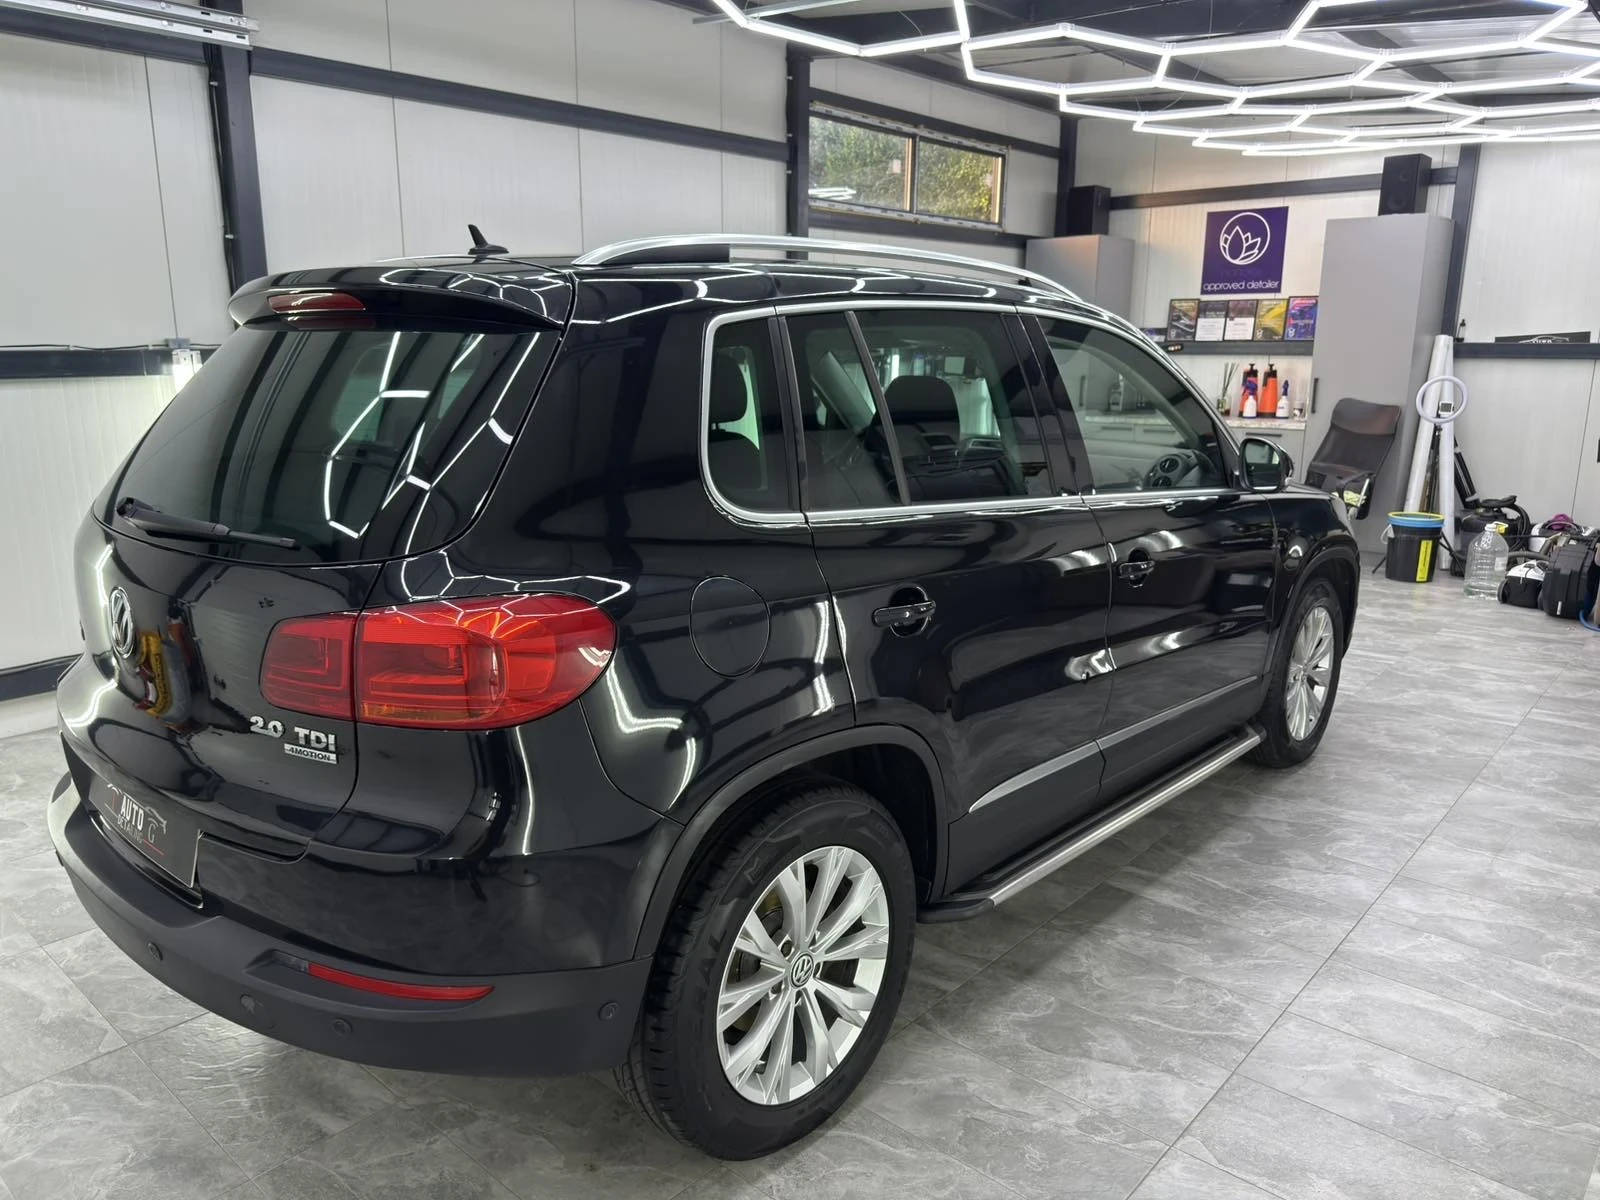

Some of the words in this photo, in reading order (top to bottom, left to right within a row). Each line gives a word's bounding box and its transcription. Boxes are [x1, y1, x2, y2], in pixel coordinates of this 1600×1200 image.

[1203, 281, 1245, 292] approved
[1247, 279, 1280, 289] detailer
[294, 726, 336, 751] TDI
[287, 746, 331, 761] 4MOTION
[120, 795, 145, 831] AUTO
